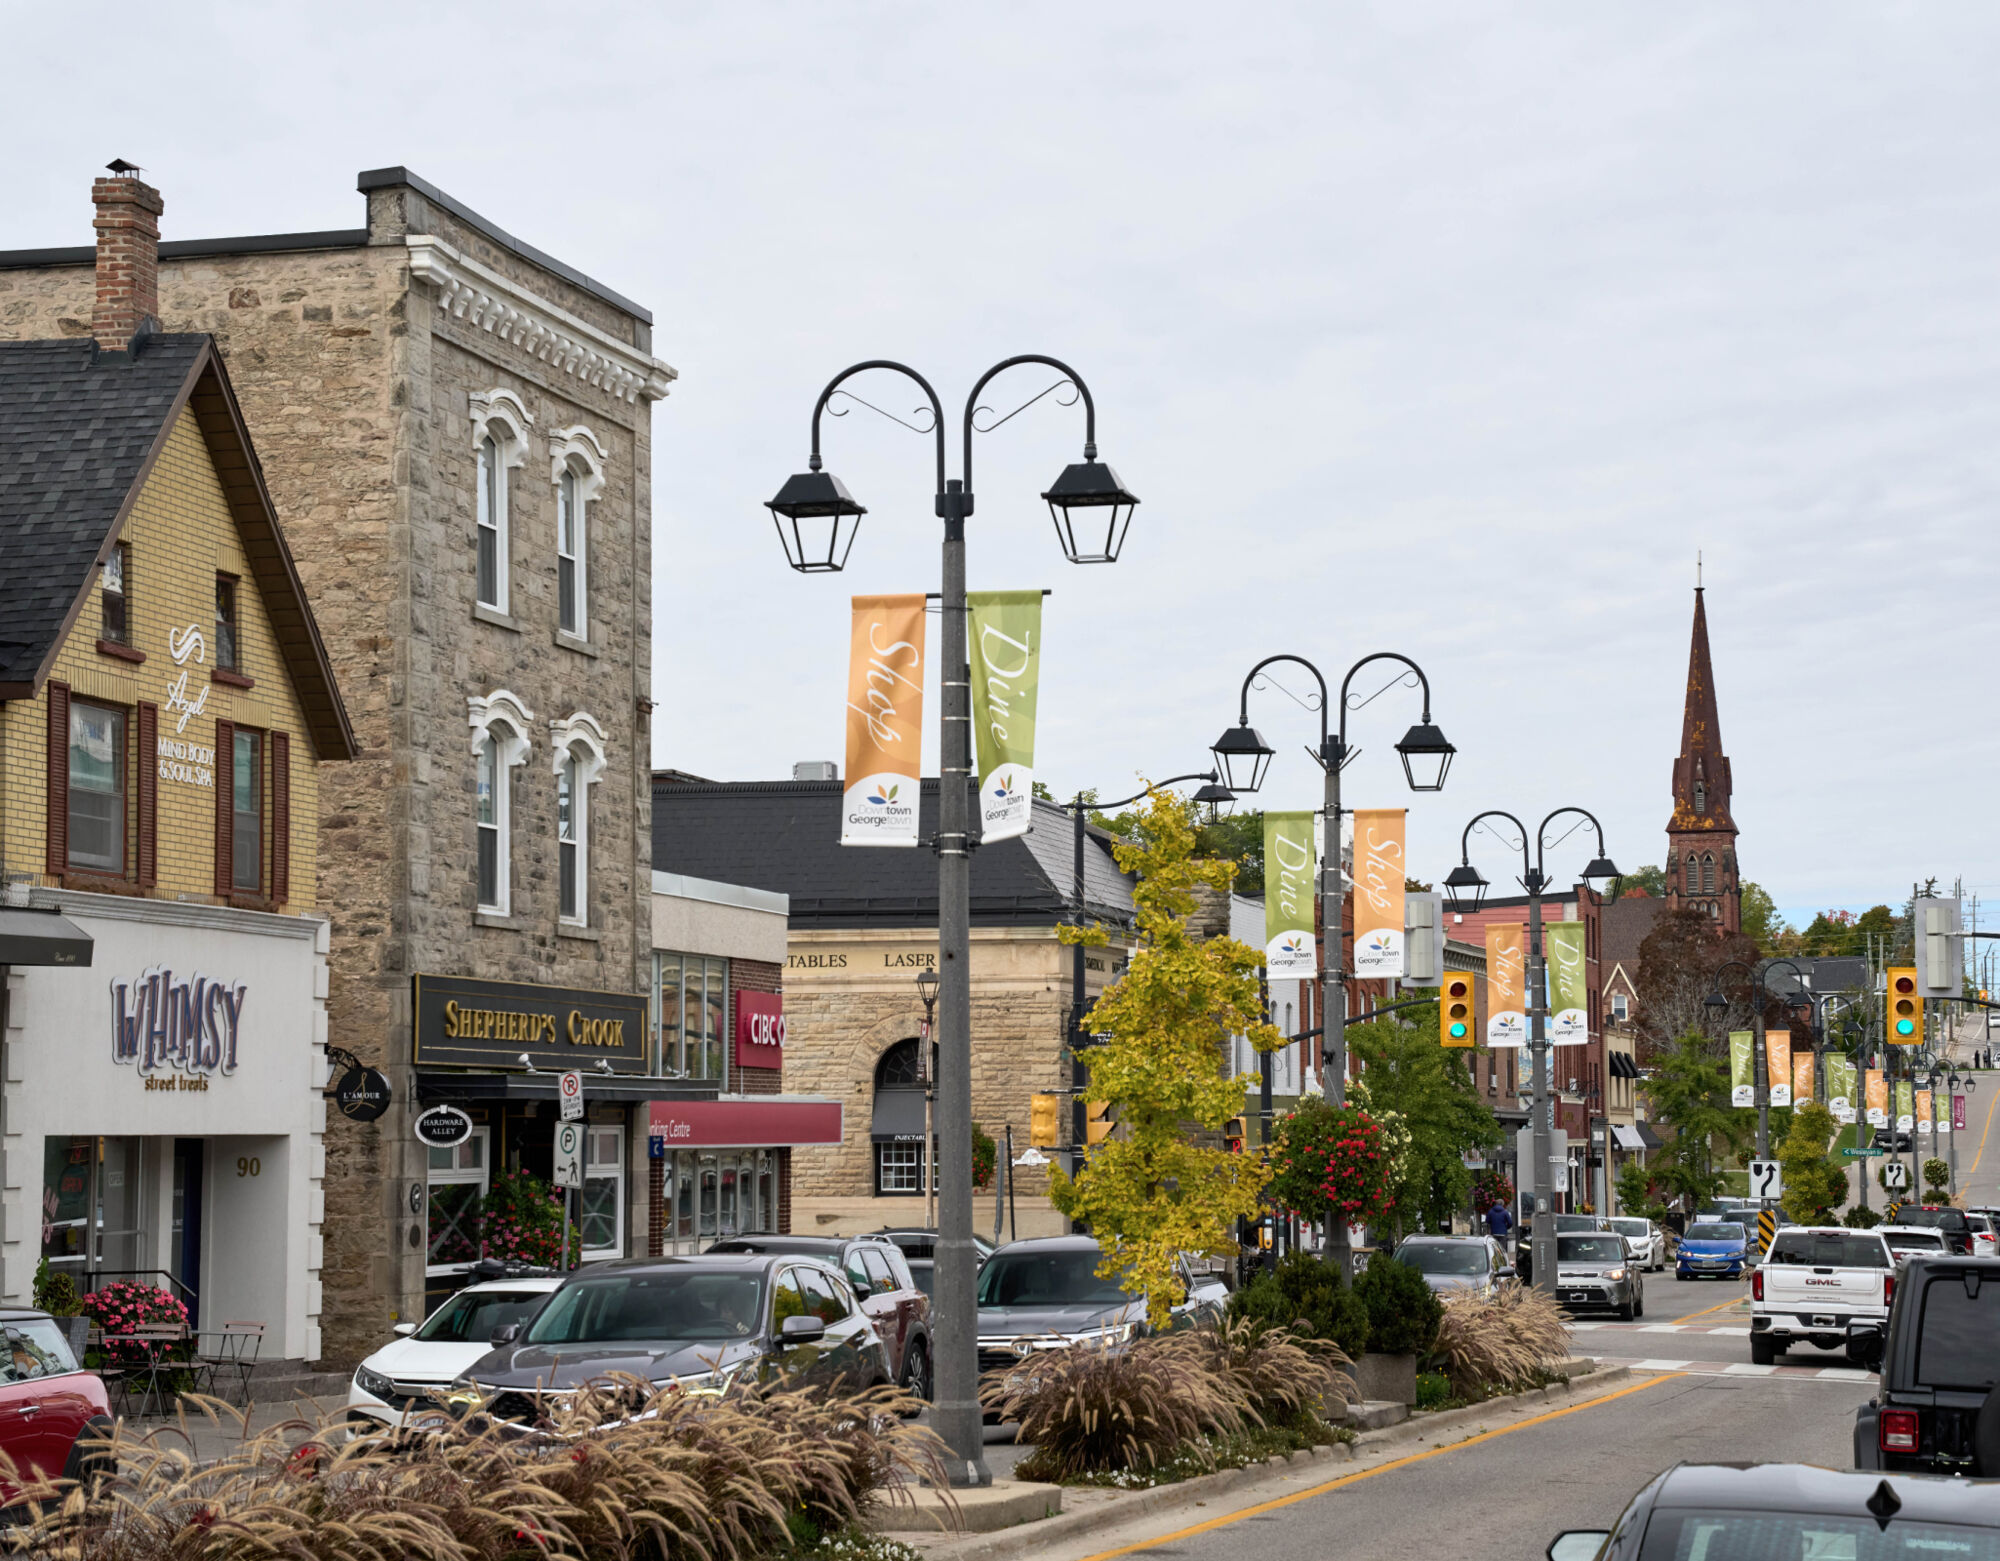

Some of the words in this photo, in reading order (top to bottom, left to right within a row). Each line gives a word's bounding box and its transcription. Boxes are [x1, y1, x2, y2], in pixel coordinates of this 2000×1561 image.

[847, 622, 923, 752] Shop
[981, 622, 1029, 750] Dine
[165, 671, 209, 734] Azul
[158, 737, 186, 760] MIND
[188, 743, 215, 767] BODY
[196, 766, 213, 787] SPA
[849, 812, 912, 827] Georgetown
[1275, 832, 1309, 920] Dine
[1350, 826, 1404, 917] Shop
[782, 953, 847, 969] TABLES
[885, 953, 937, 968] LASER
[1486, 937, 1521, 1001] Shop
[1554, 937, 1580, 1002] Dine
[114, 968, 248, 1072] WHIMSY
[751, 1013, 776, 1046] CIBC
[145, 1073, 176, 1092] street
[180, 1074, 209, 1092] treats
[423, 1118, 464, 1127] HARDWARE
[432, 1127, 456, 1135] ALLEY
[669, 1119, 691, 1138] Centre
[237, 1156, 261, 1177] 90
[1805, 1278, 1842, 1287] GMC
